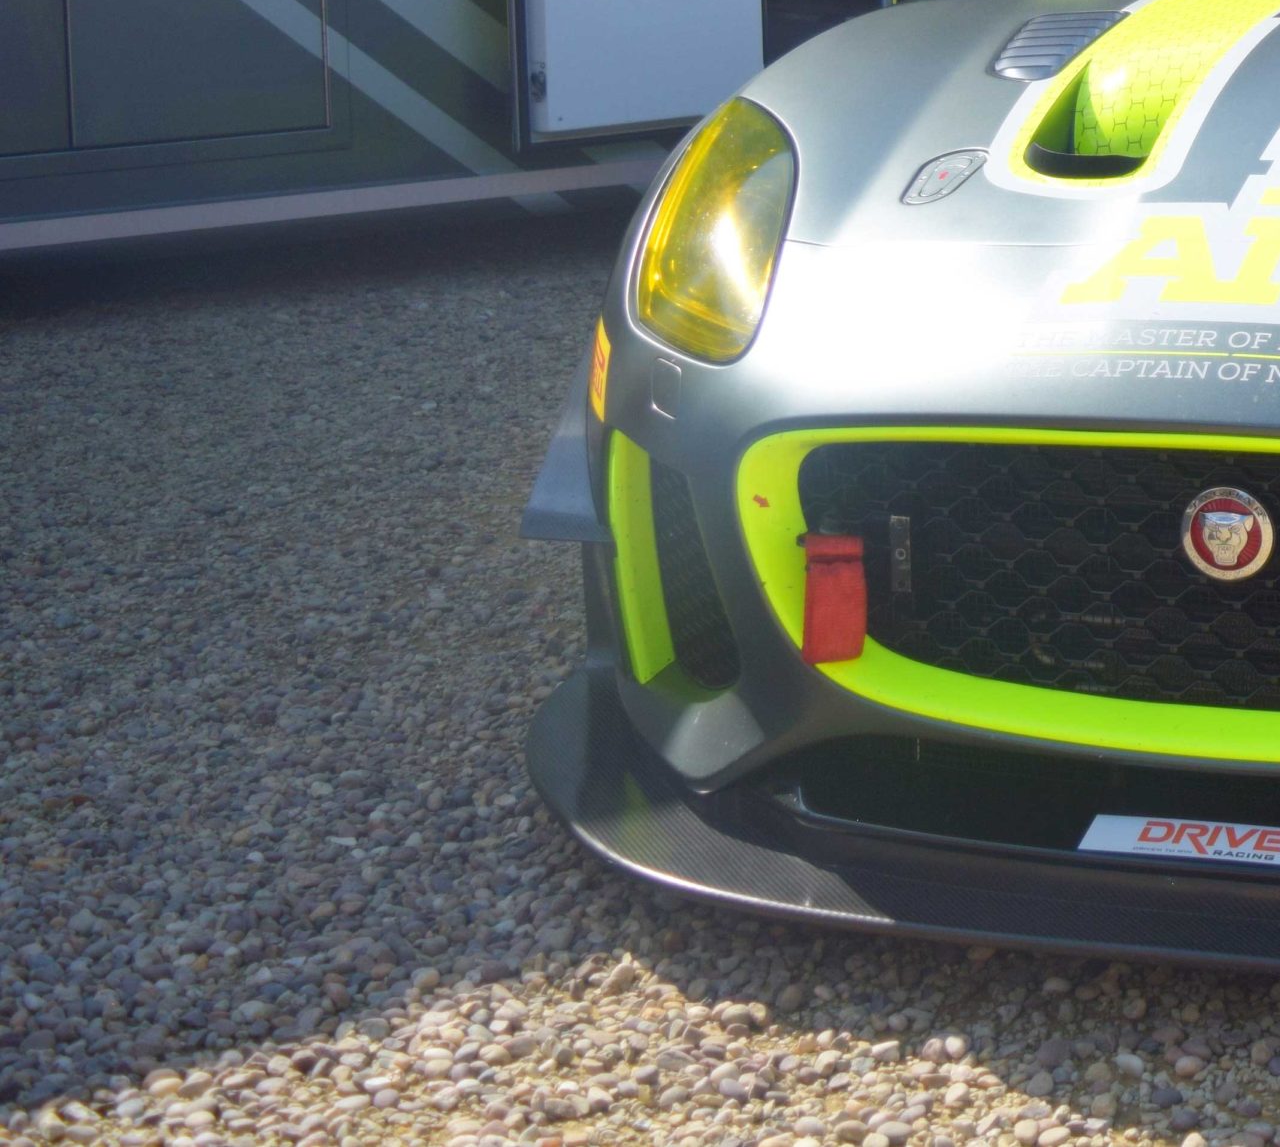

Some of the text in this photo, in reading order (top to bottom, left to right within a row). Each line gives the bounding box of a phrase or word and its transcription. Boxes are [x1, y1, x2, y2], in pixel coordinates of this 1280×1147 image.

[1227, 330, 1272, 349] OF
[1071, 359, 1213, 380] CAPTAIN
[1217, 361, 1263, 381] OF
[1212, 849, 1275, 862] RACING
